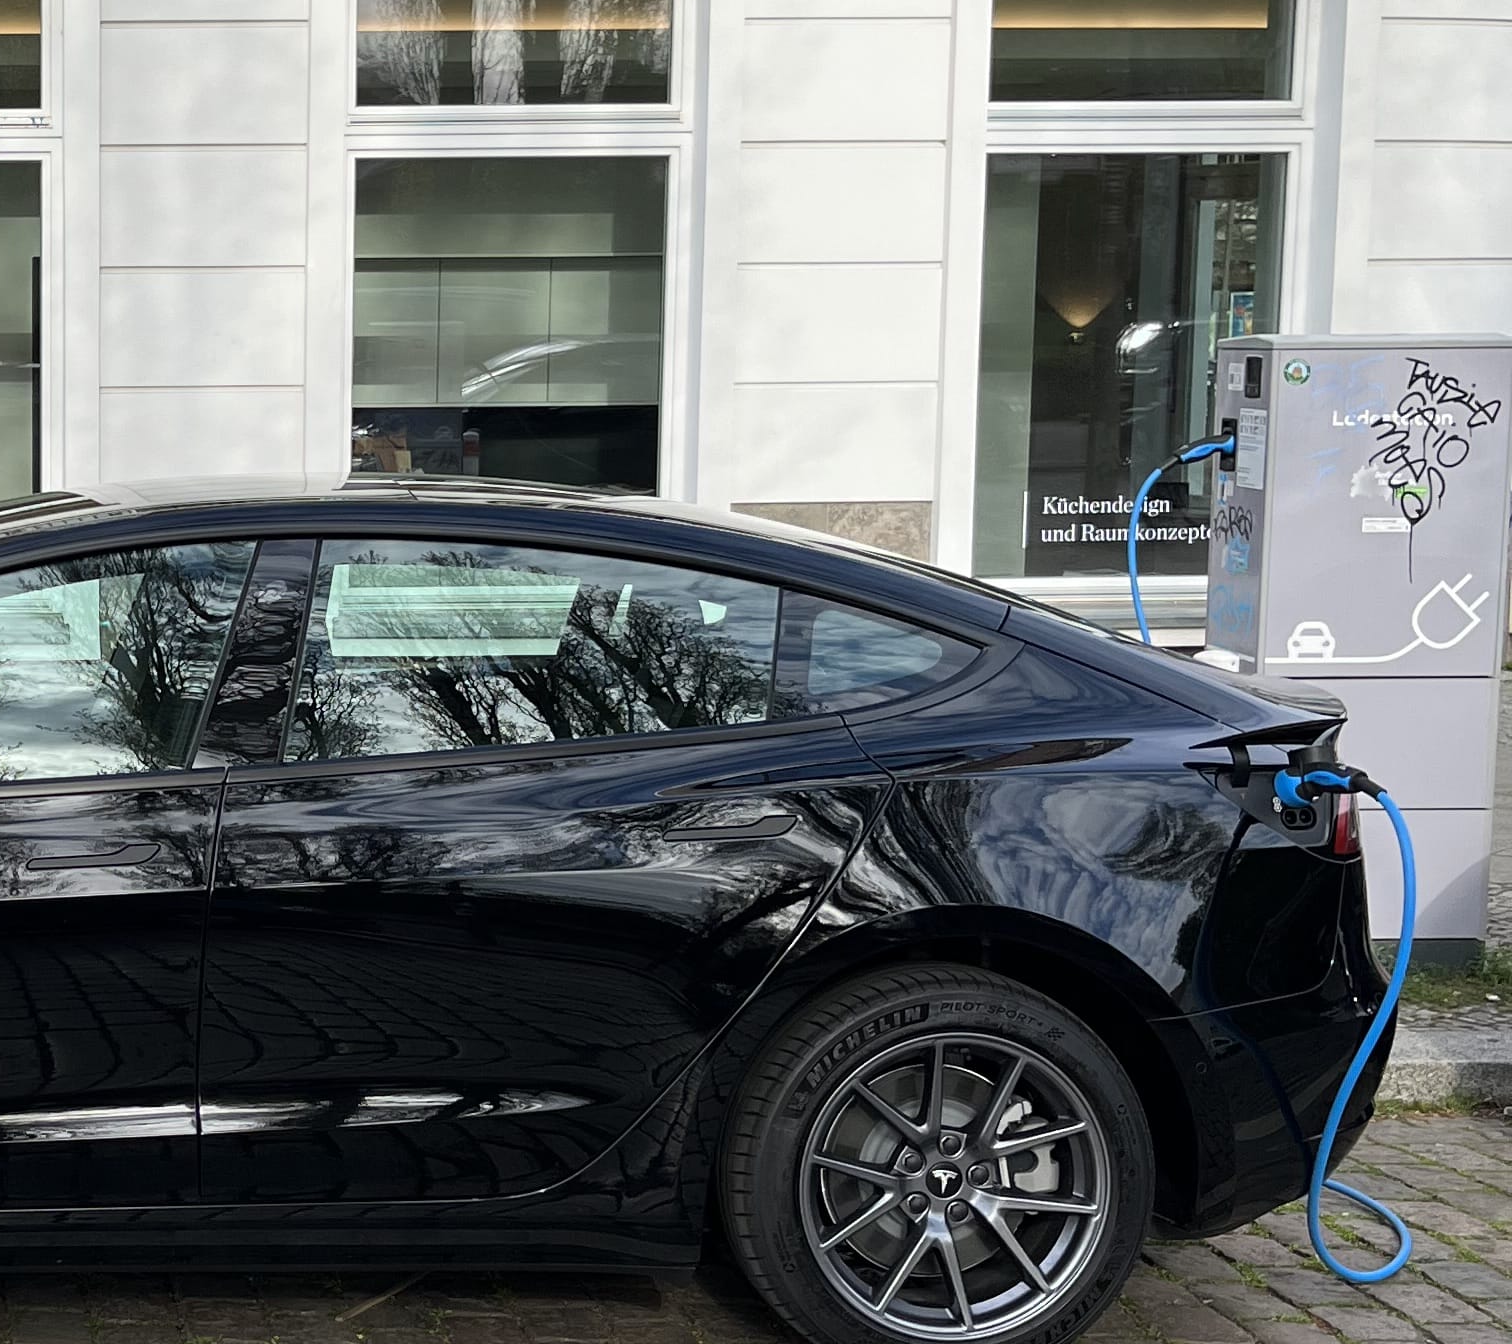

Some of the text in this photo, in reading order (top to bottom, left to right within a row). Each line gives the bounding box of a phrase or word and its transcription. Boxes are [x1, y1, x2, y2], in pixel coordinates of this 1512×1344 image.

[1042, 495, 1170, 518] Küchendeign
[1041, 526, 1076, 543] und
[806, 1002, 1035, 1089] MICHELIN PILOT SPORT
